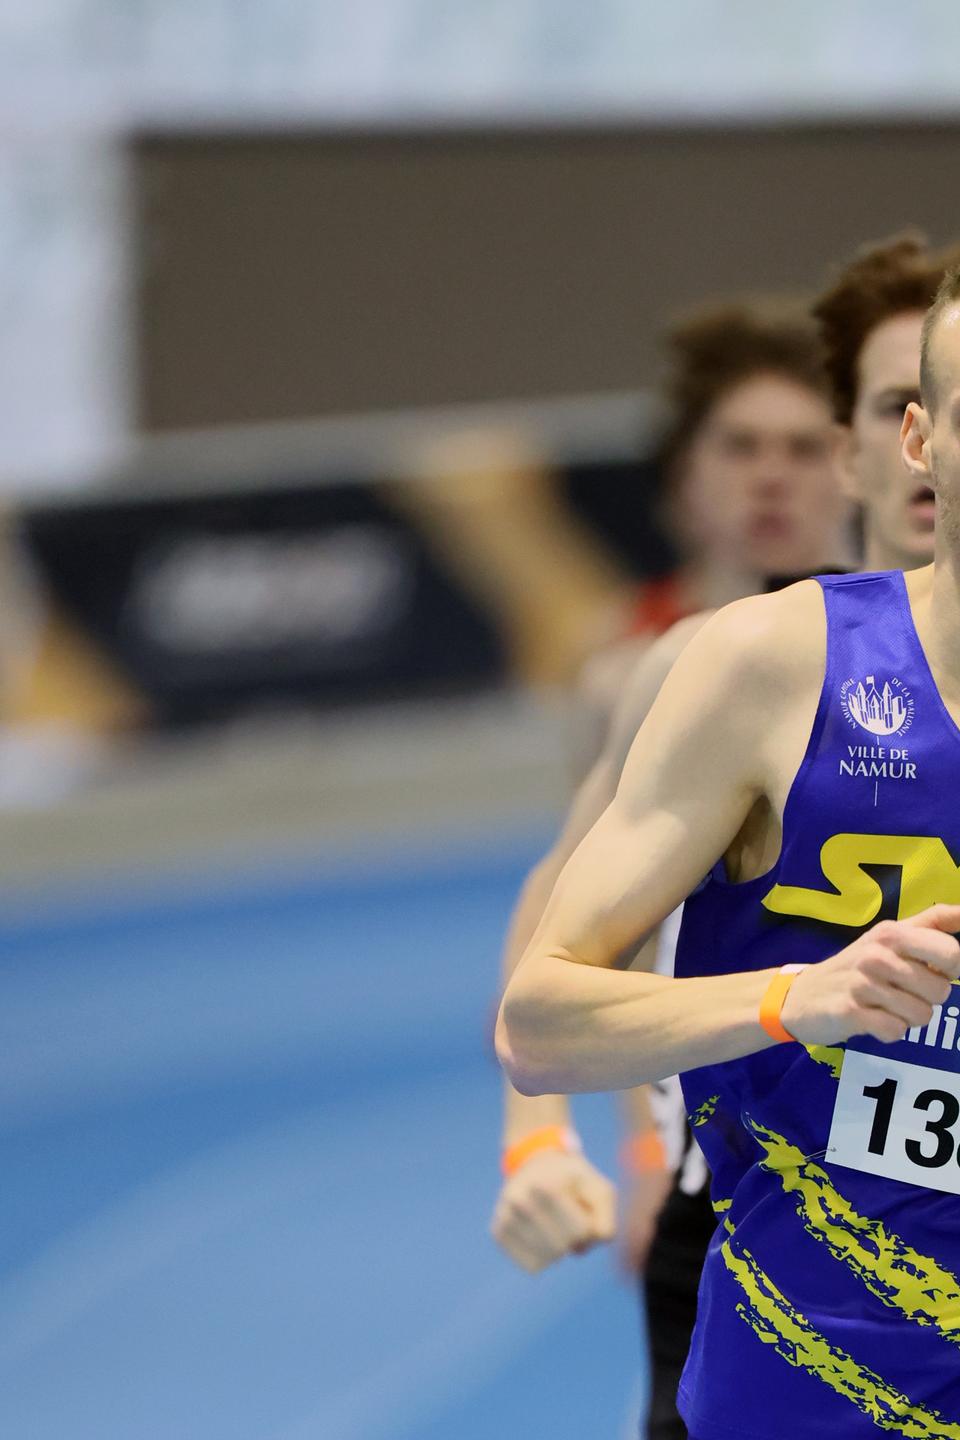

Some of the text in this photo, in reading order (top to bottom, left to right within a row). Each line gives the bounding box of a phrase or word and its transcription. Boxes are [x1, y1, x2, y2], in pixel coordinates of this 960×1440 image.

[891, 677, 903, 688] DE
[901, 687, 911, 698] LA
[896, 699, 915, 737] WALLONIE
[847, 745, 909, 761] VILLE DE
[839, 760, 917, 779] NAMUR
